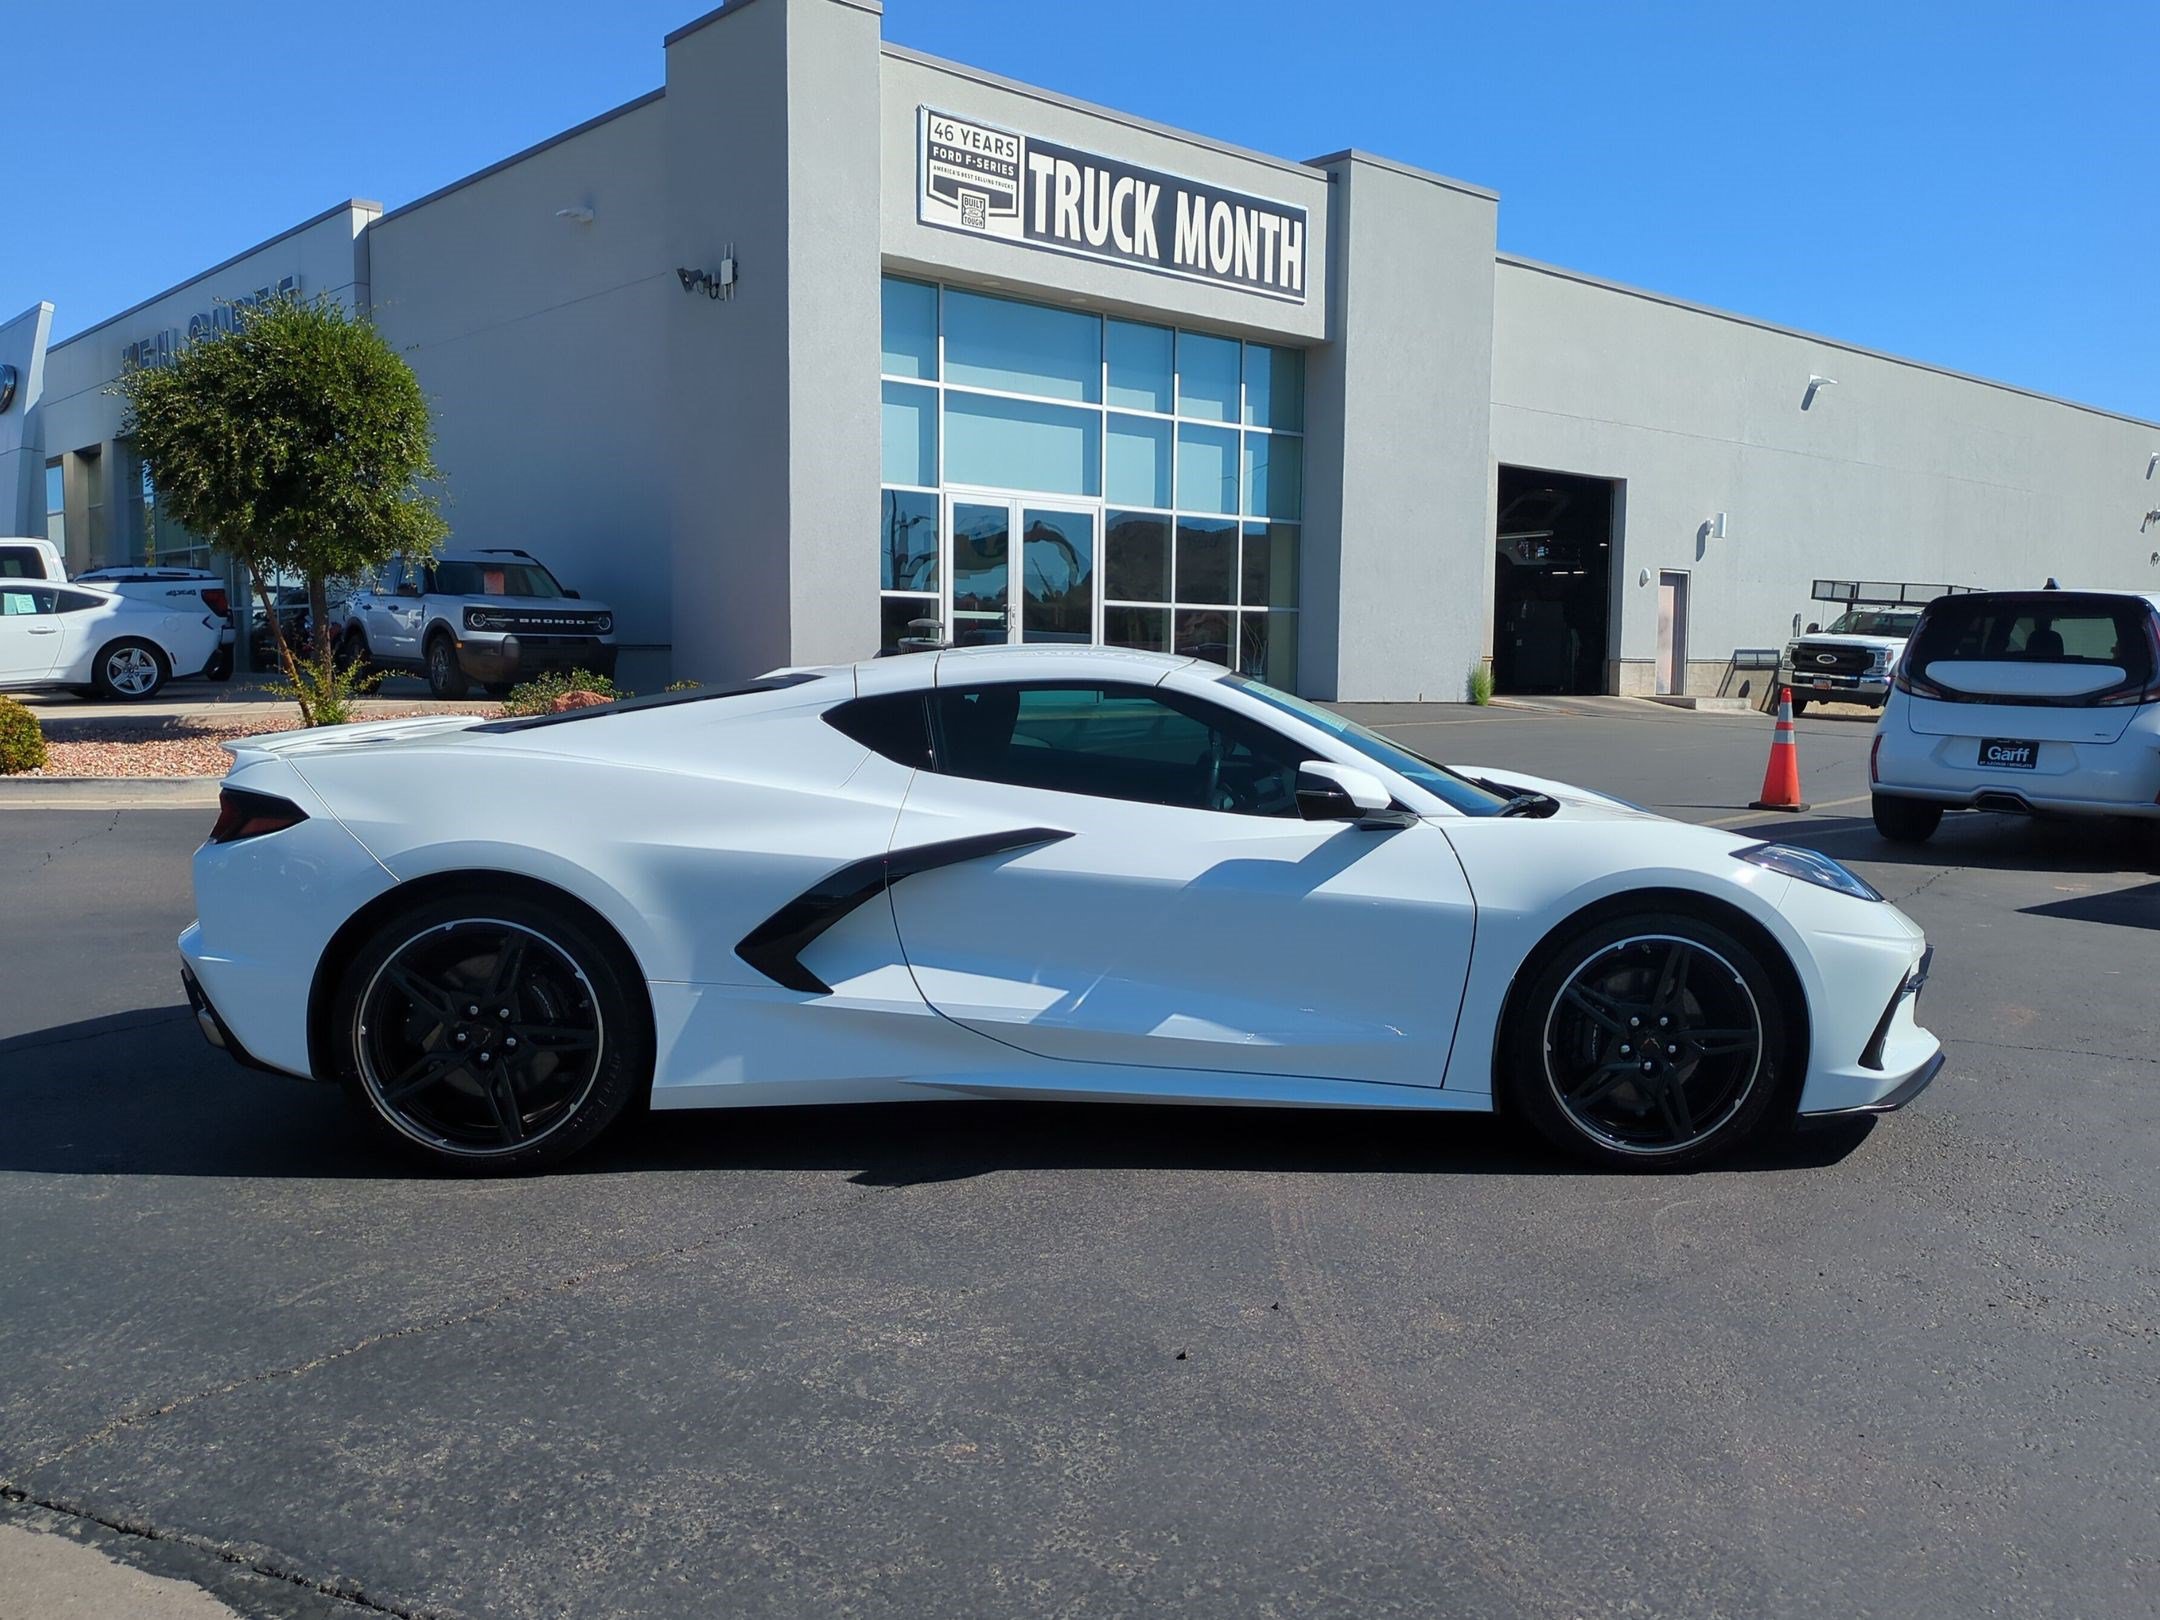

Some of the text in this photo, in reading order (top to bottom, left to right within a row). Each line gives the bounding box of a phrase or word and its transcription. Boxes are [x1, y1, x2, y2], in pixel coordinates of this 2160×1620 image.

[934, 122, 1015, 158] 46 YEARS
[933, 146, 1015, 176] FORD F-SERIES
[933, 165, 1014, 190] AMERICA'S BEST SELLING TRUCKS
[964, 197, 983, 209] BUILT
[964, 217, 983, 227] TOUGH
[1029, 151, 1303, 291] TRUCK MONTH
[519, 617, 586, 625] BRONCO
[1987, 745, 2030, 762] Garff
